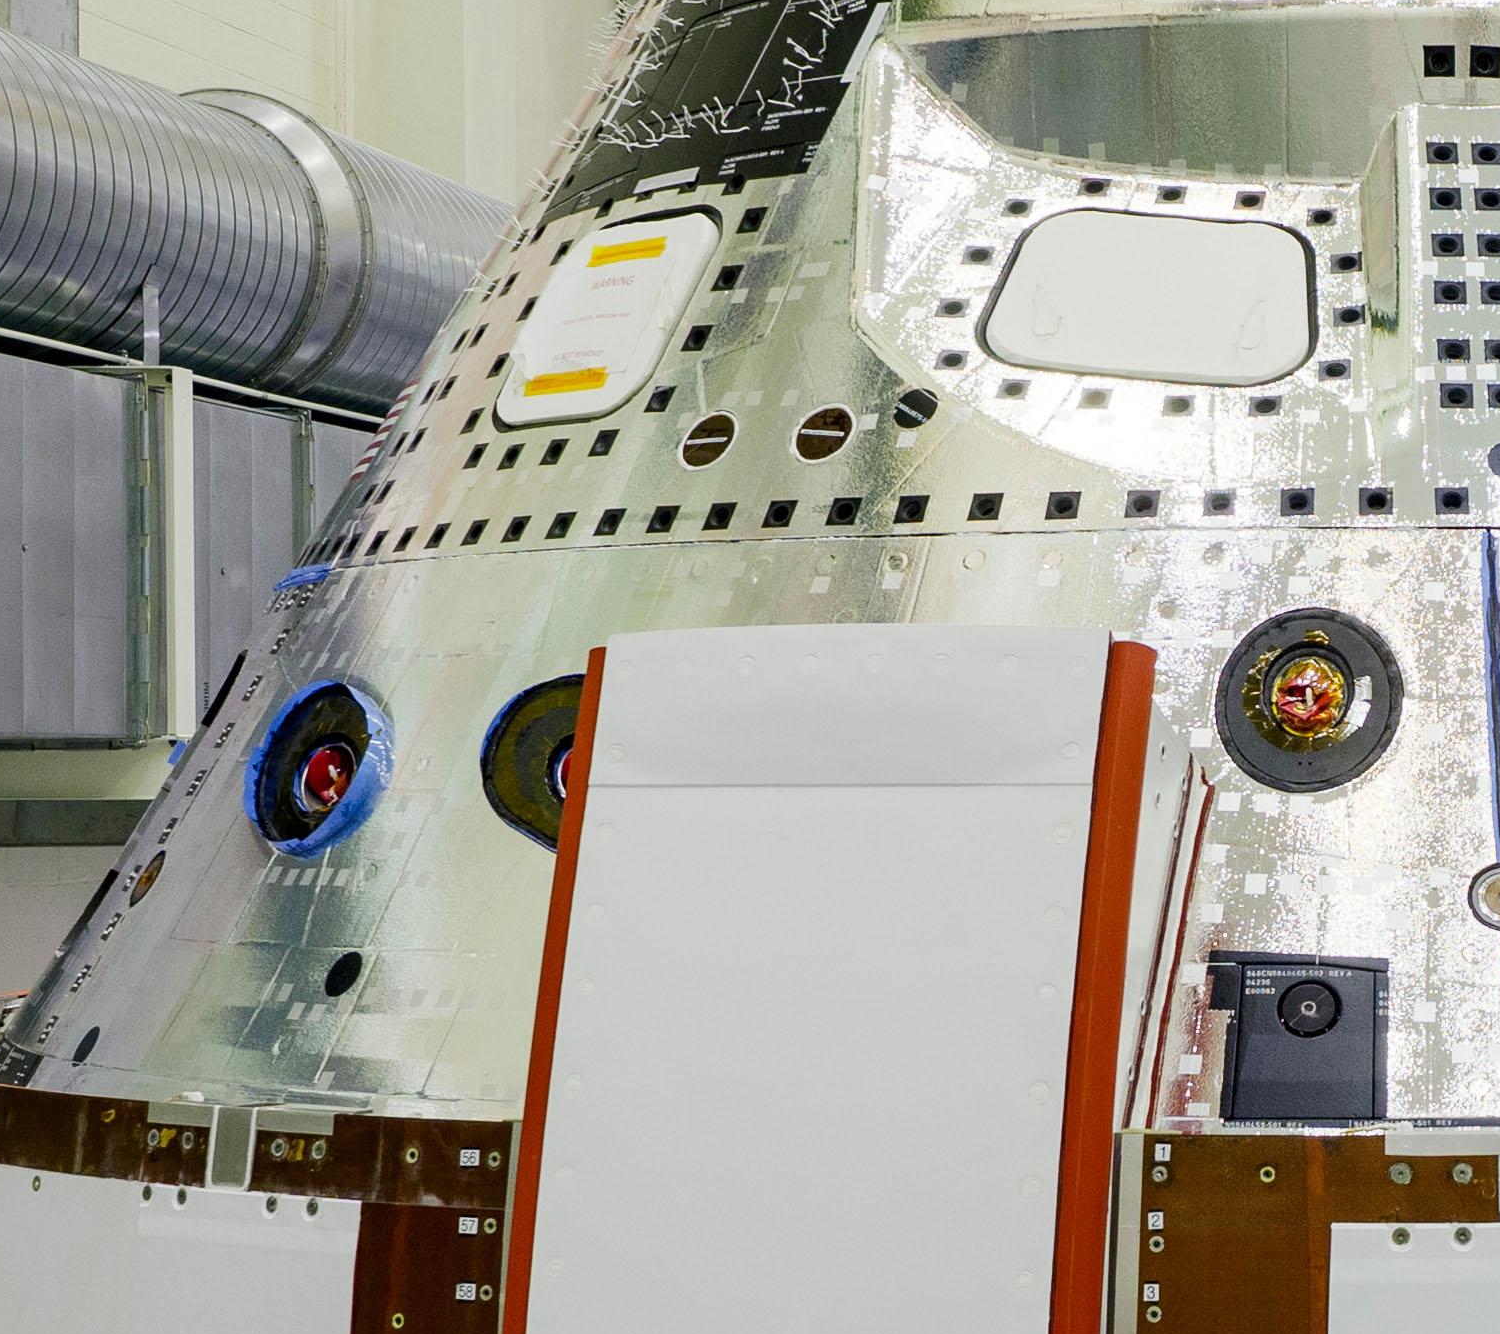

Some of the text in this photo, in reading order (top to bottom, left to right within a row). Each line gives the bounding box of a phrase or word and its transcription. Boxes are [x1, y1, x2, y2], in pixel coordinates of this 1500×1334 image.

[465, 1151, 479, 1164] 56
[460, 1220, 475, 1231] 57
[1152, 1214, 1160, 1227] 2
[458, 1285, 473, 1298] 58
[1147, 1286, 1155, 1299] 3
